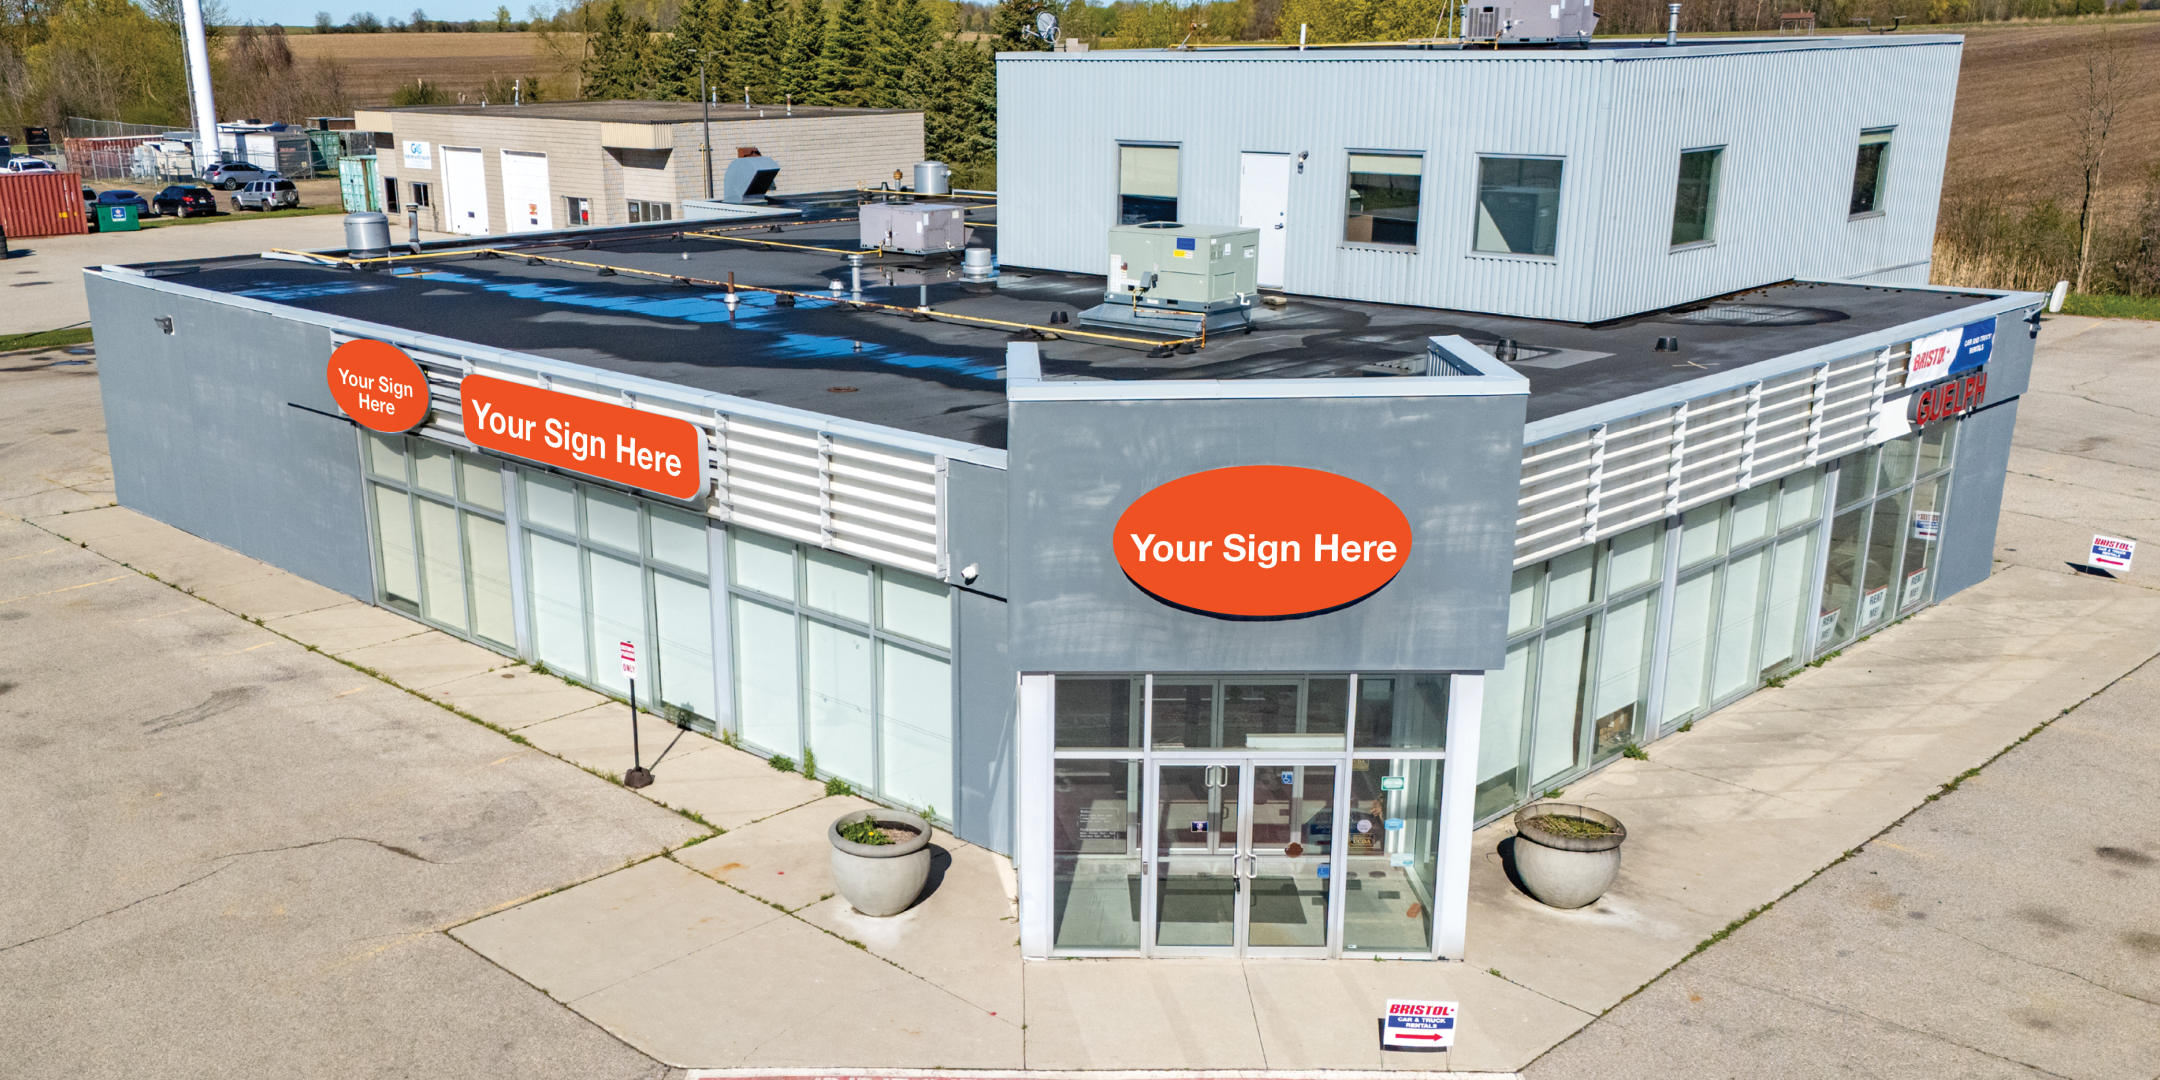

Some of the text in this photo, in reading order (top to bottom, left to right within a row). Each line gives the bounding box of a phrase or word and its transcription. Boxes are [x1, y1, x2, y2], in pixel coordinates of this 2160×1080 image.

[338, 367, 413, 399] Your Sign
[358, 392, 395, 415] Here
[1916, 372, 1987, 425] GUELPH
[471, 398, 682, 477] Your Sign Here
[1130, 533, 1397, 569] Your Sign Here
[2094, 538, 2129, 550] BRISTOL
[1911, 572, 1924, 587] RENT
[1869, 591, 1884, 606] RENT
[1822, 612, 1837, 627] RENT
[1389, 1003, 1450, 1016] BRISTOL
